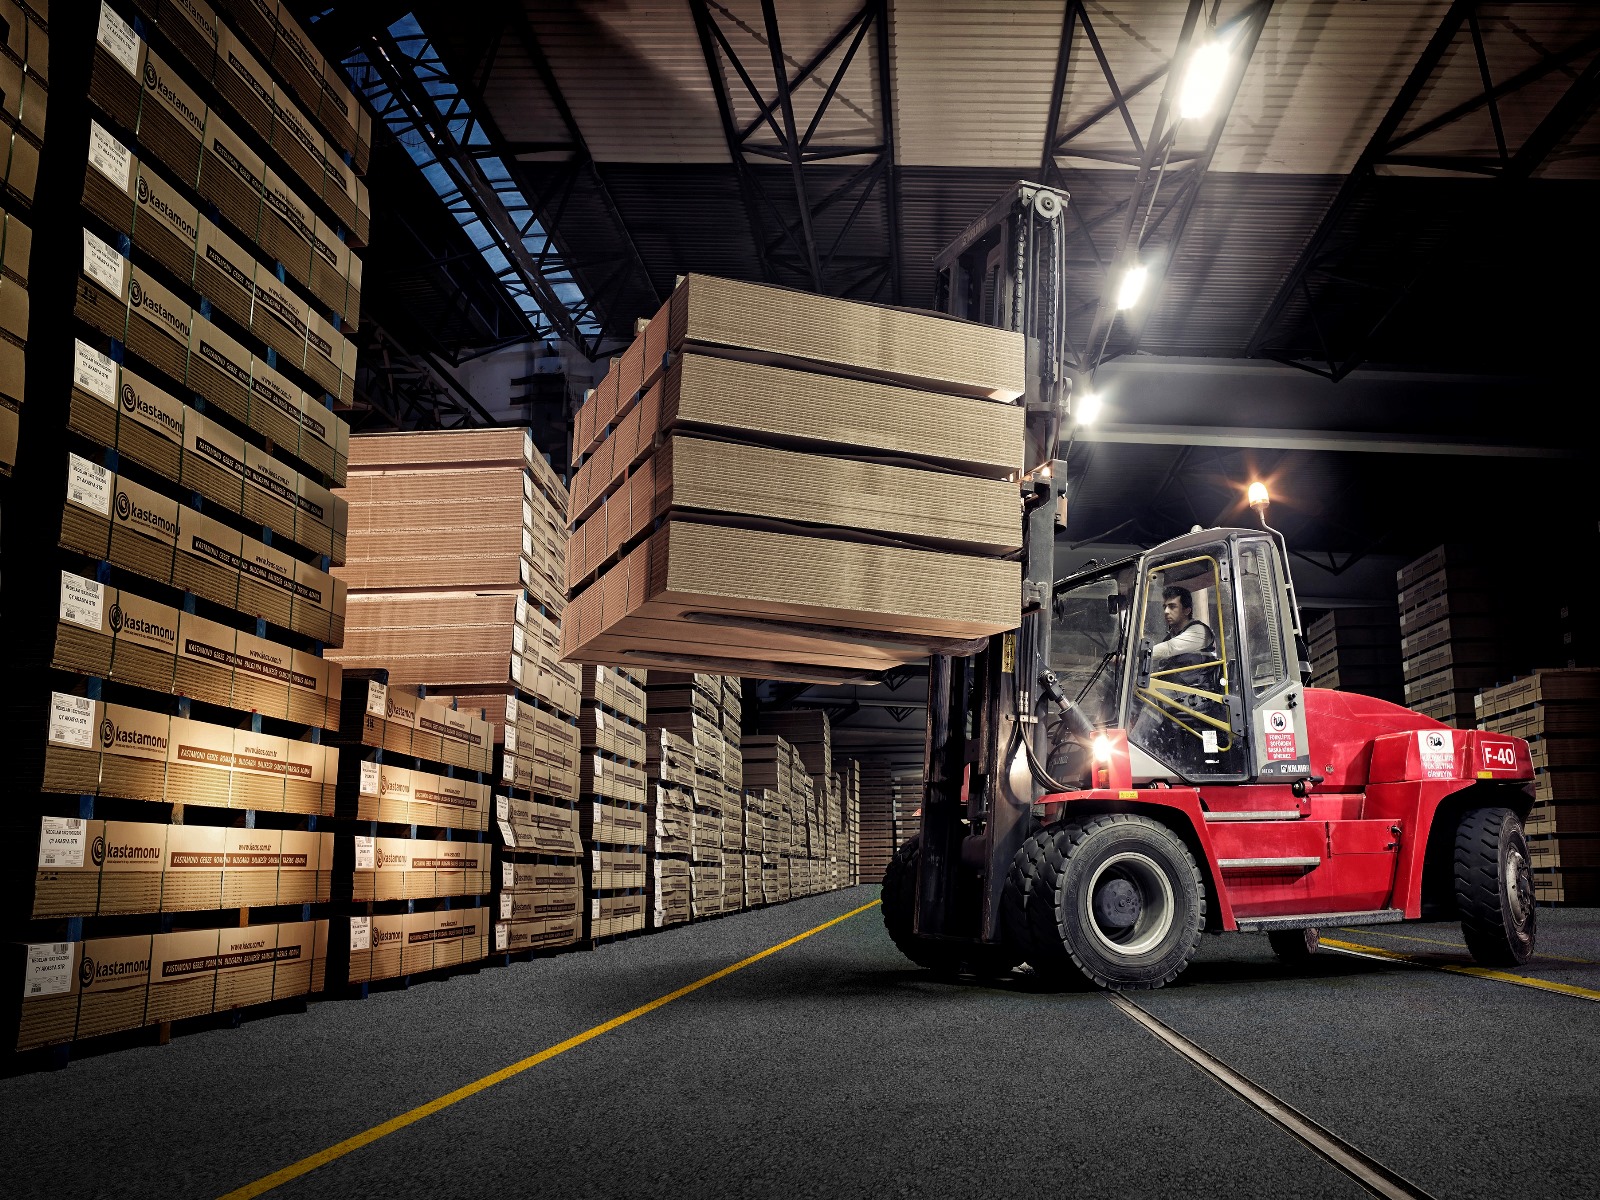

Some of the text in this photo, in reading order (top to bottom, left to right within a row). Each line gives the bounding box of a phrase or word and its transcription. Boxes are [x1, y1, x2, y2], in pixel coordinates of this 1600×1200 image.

[158, 76, 204, 132] kastamonu
[150, 190, 197, 240] kastamonu
[143, 295, 190, 337] kastamonu
[137, 394, 184, 435] kastamonu
[131, 501, 181, 537] kastamonu
[124, 612, 175, 642] kastamonu
[116, 725, 167, 748] kastamonu
[1484, 747, 1515, 765] F-40
[107, 841, 160, 859] kastamonu
[96, 959, 150, 977] kastamonu
